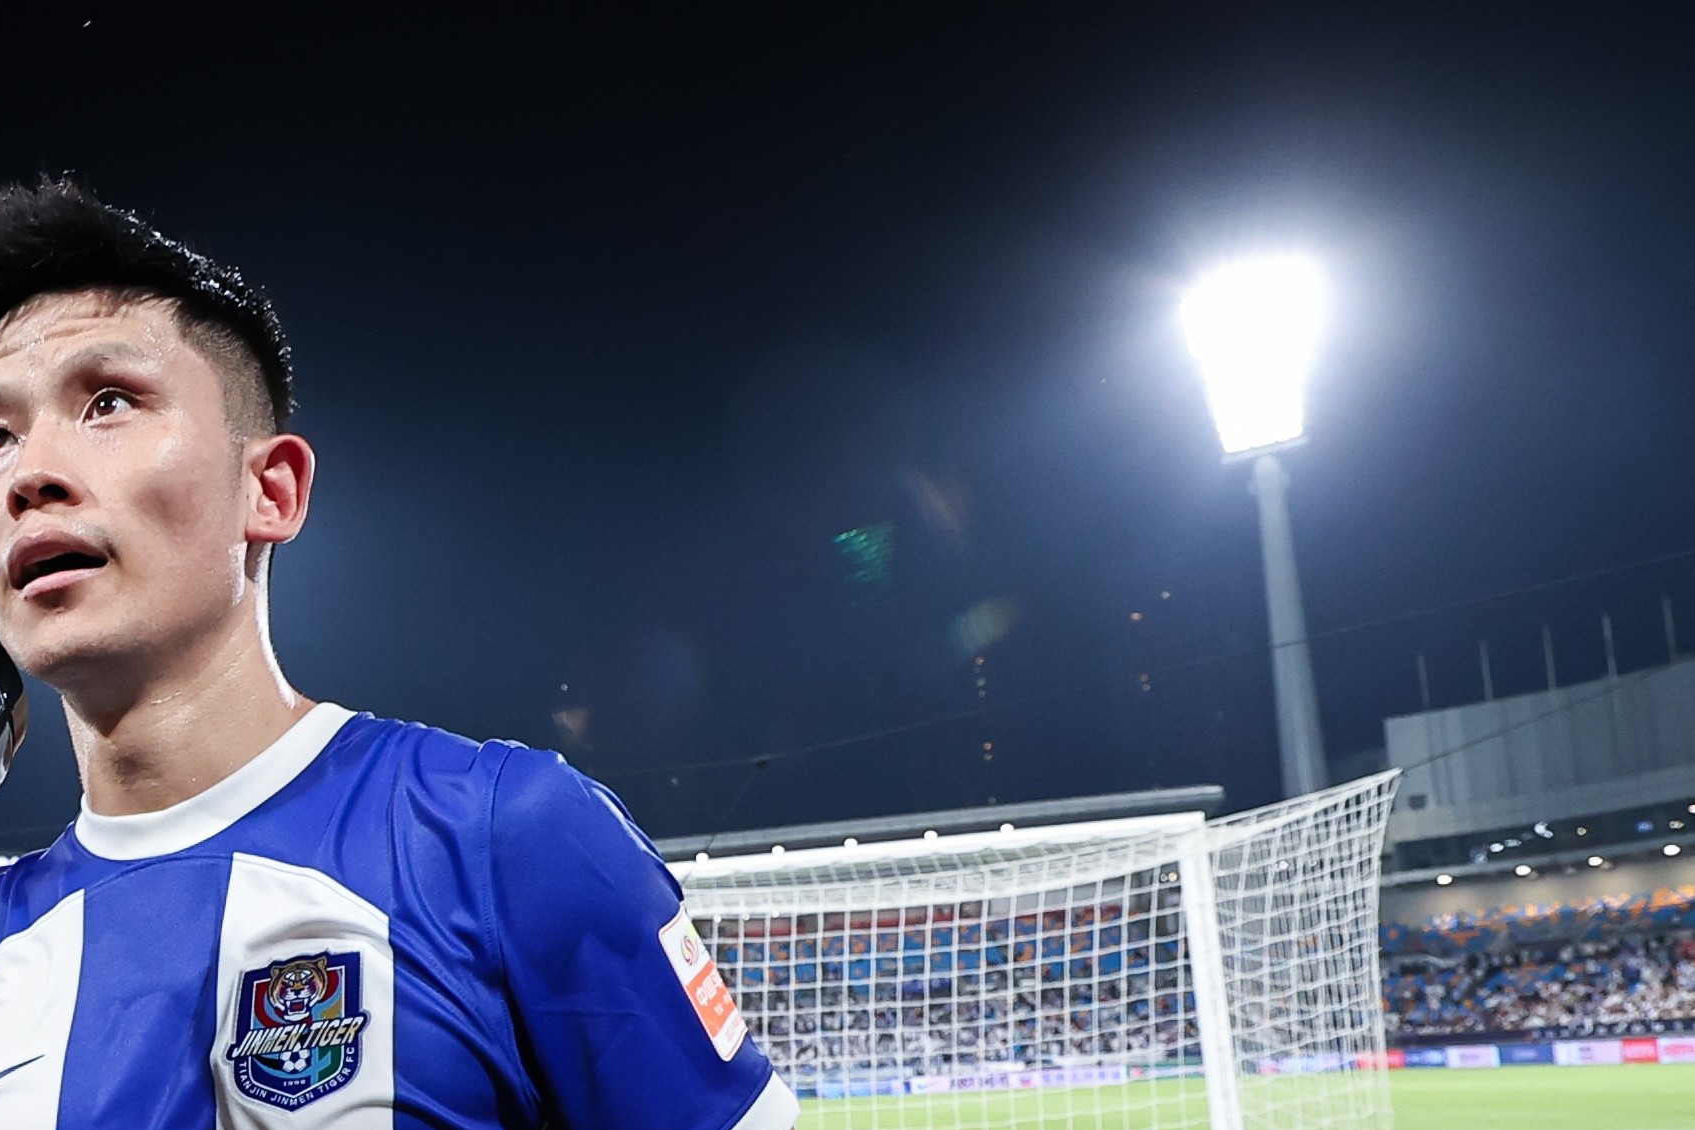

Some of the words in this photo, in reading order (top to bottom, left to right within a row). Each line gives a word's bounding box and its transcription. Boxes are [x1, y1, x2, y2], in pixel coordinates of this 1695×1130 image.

[231, 1024, 304, 1058] JINMEN
[304, 1016, 364, 1049] TIGER
[238, 1061, 268, 1099] TIANJIN
[270, 1091, 315, 1106] JINMEN
[319, 1067, 352, 1094] TIGER
[345, 1046, 355, 1063] FC
